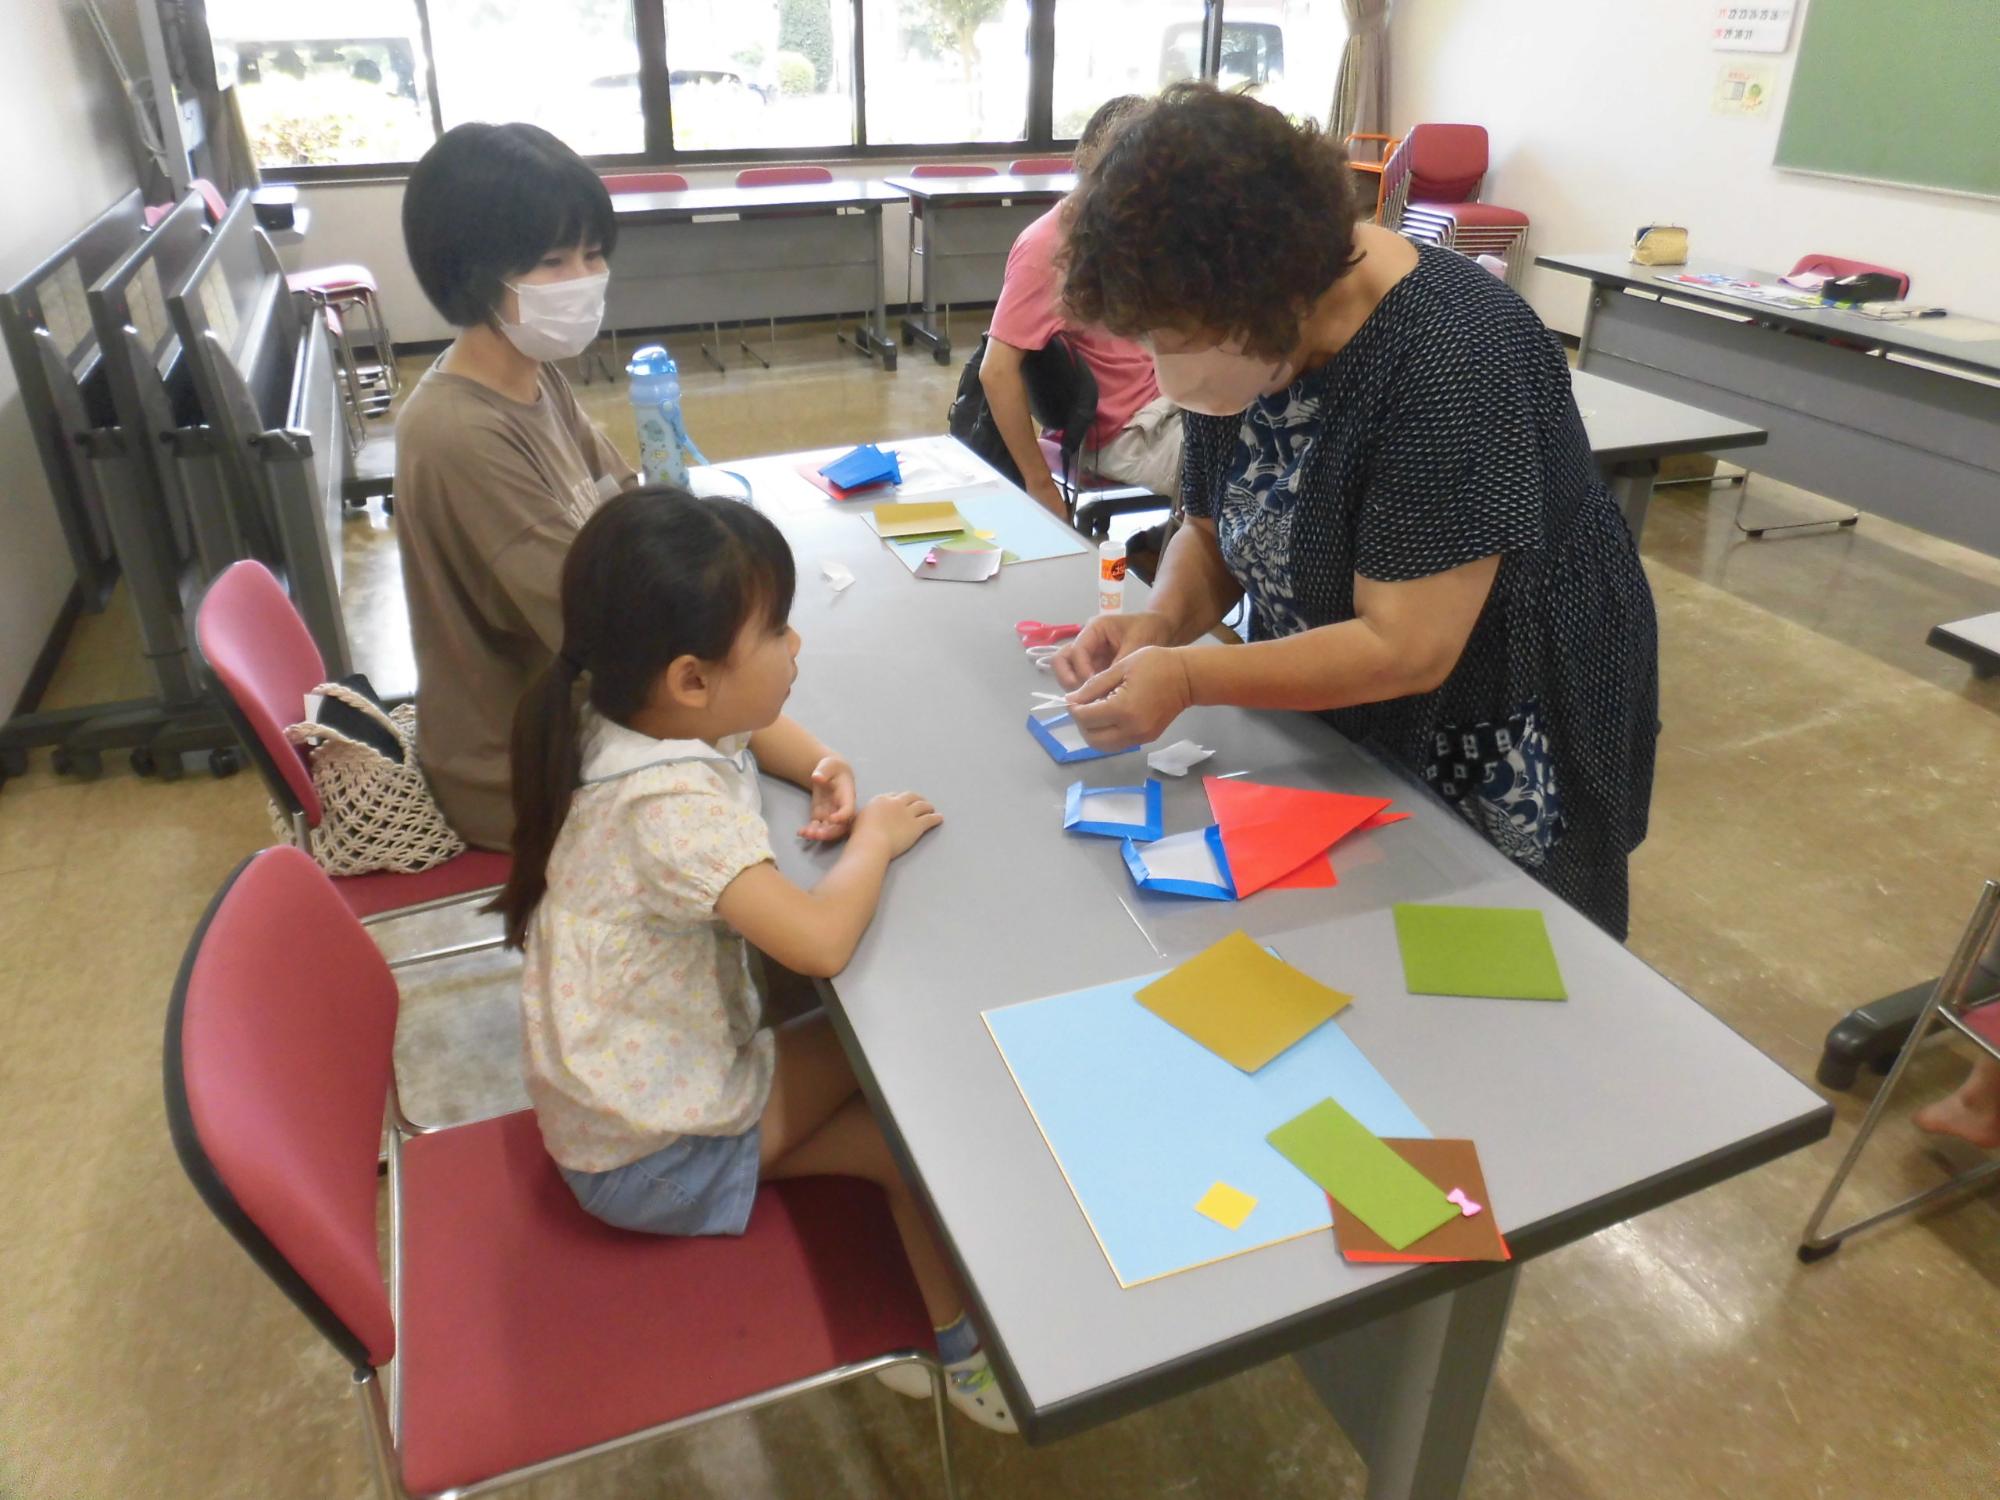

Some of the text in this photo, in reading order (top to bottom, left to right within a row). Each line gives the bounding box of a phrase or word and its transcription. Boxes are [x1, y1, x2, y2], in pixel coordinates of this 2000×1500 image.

[1728, 8, 1737, 19] 22
[1738, 9, 1748, 19] 23
[1748, 9, 1758, 20] 24
[1760, 9, 1769, 20] 25
[1744, 29, 1753, 40] 31
